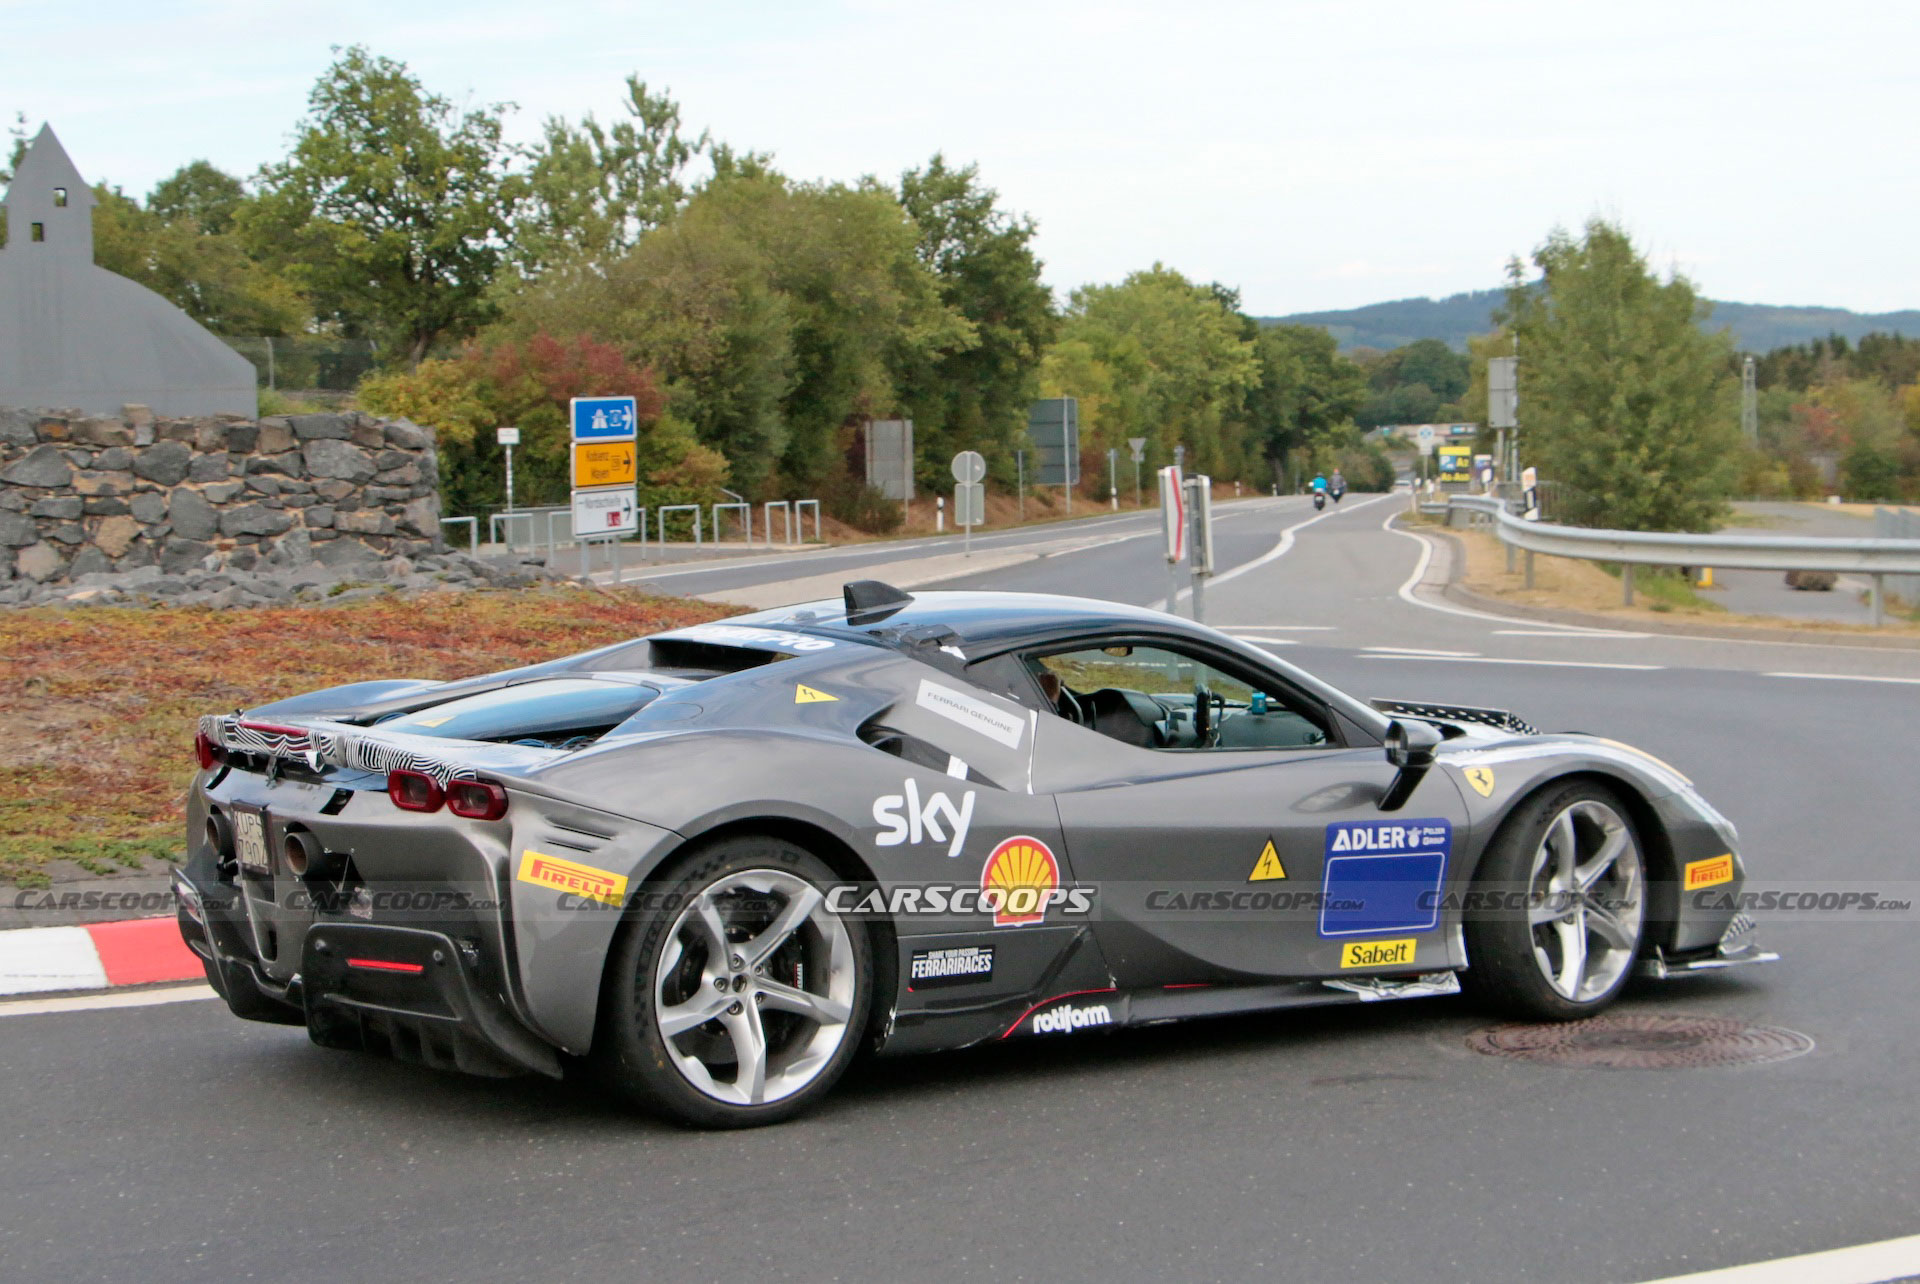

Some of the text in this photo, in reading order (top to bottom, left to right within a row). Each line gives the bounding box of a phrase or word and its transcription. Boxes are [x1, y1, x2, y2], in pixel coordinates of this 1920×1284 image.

[927, 691, 1013, 734] FERRARI GENUINE
[872, 777, 975, 857] sky
[1331, 826, 1406, 852] ADLER
[529, 859, 615, 899] PIRELLI
[1690, 860, 1730, 886] PIRELLI
[912, 954, 992, 978] FERRARIRACES
[1349, 943, 1407, 965] Sabelt
[1033, 1005, 1109, 1033] rotiform
